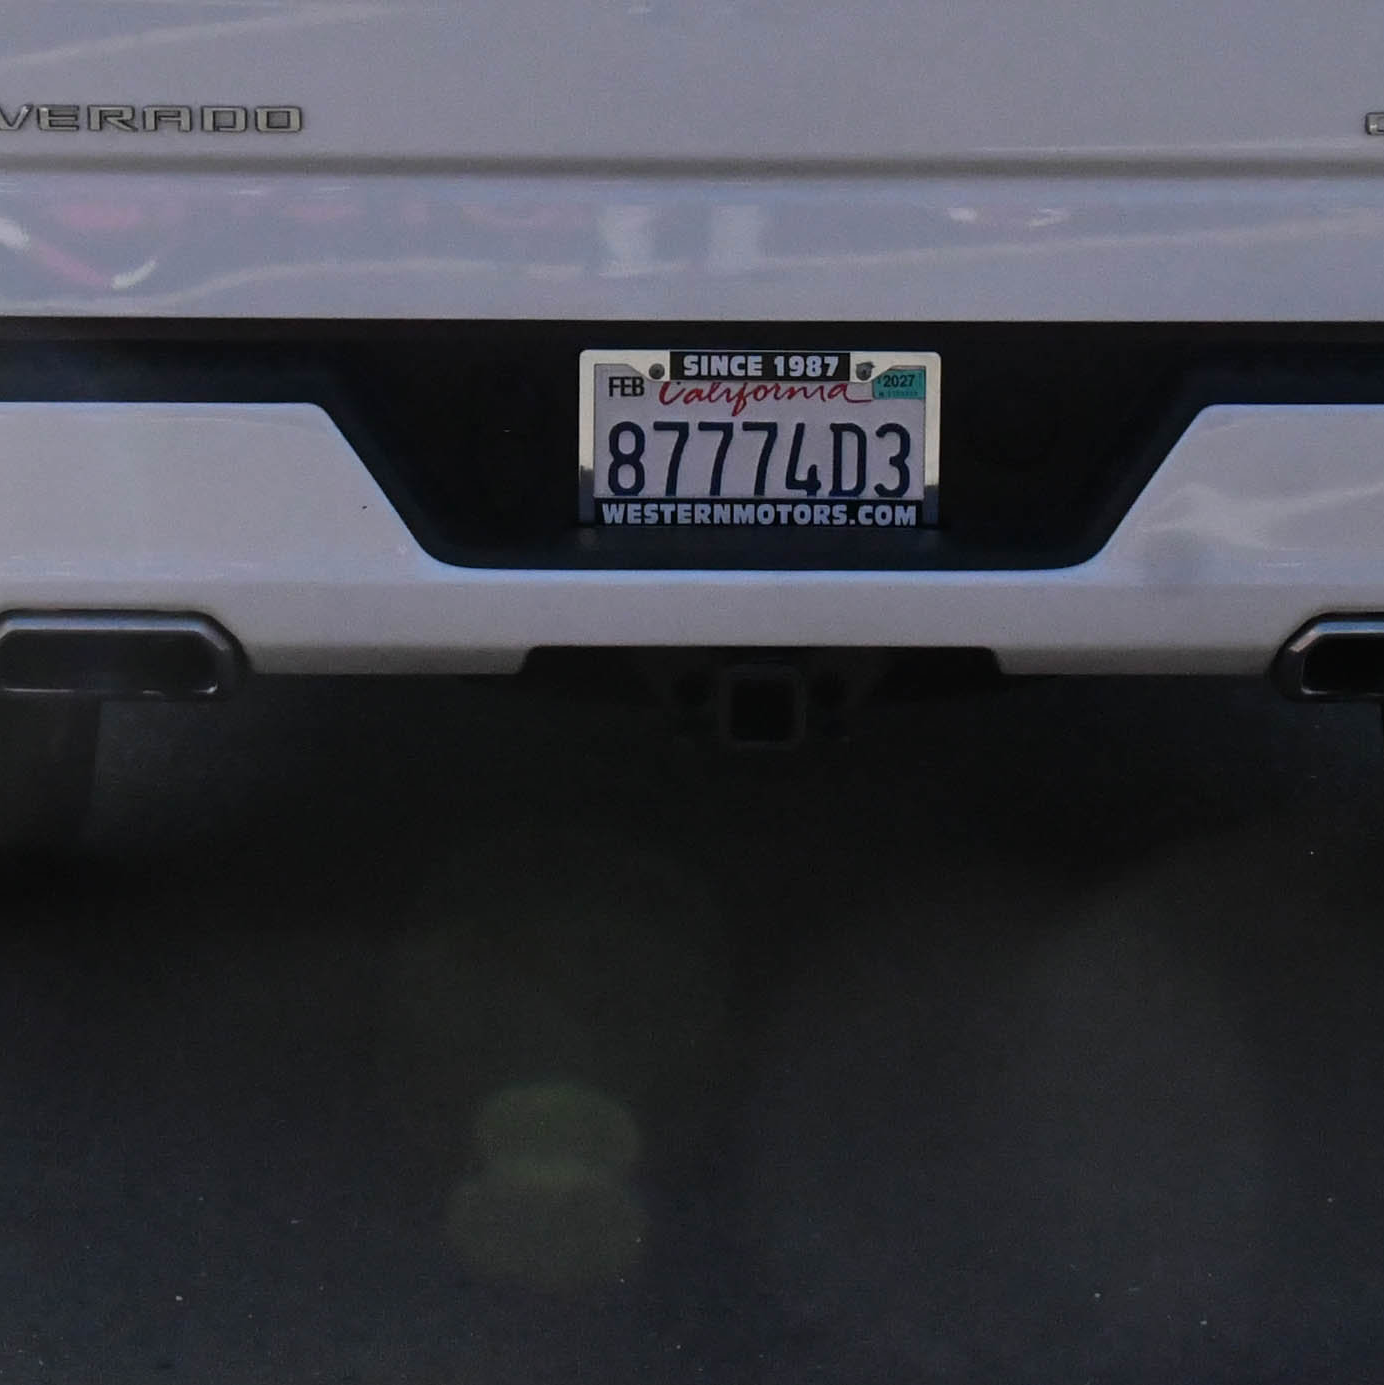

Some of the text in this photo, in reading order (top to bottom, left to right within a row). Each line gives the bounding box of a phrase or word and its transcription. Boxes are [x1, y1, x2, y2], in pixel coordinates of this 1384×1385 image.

[683, 355, 839, 377] SINCE 1987
[608, 376, 645, 397] FEB
[883, 374, 915, 388] 2027
[659, 380, 873, 417] California
[608, 421, 911, 497] 87774D3
[602, 503, 916, 526] WESTERNMOTORS.COM
